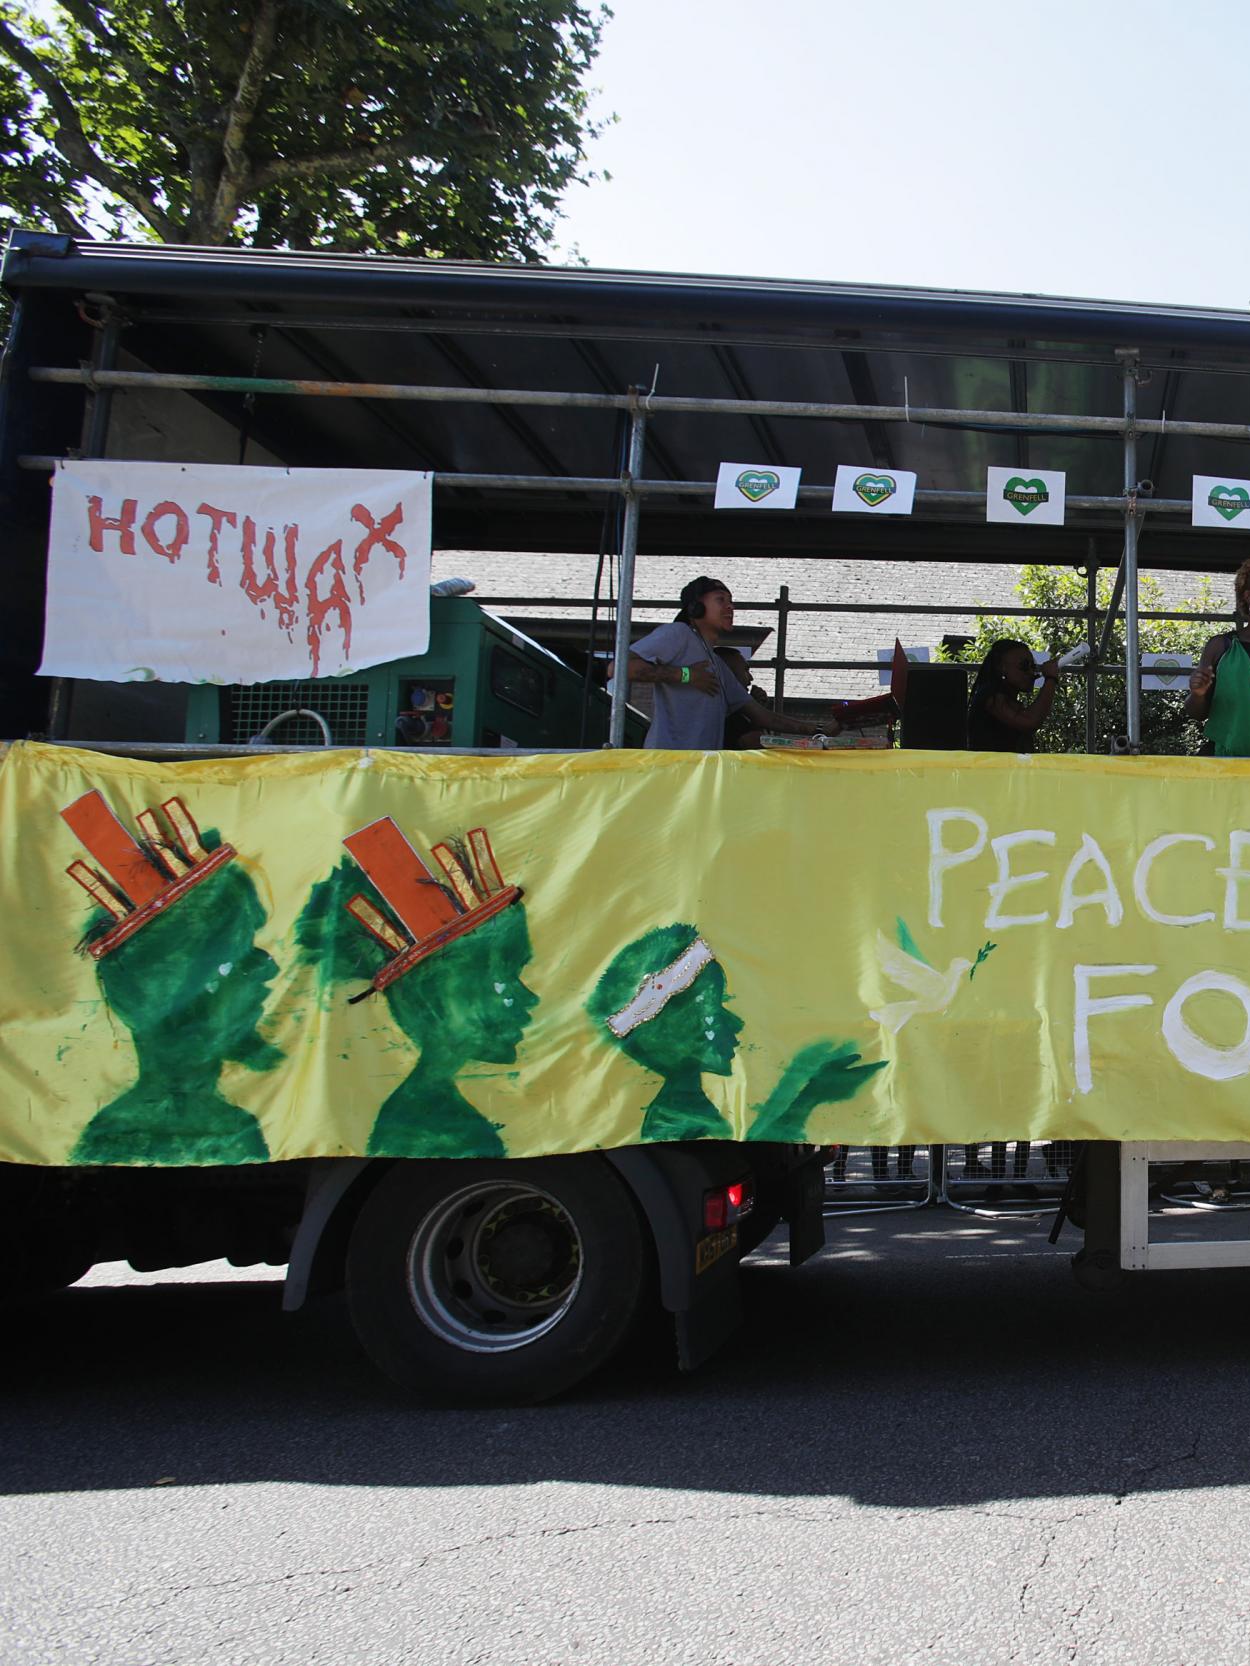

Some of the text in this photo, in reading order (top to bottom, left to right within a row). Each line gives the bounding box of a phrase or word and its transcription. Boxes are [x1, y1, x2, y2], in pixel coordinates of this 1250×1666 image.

[738, 481, 776, 490] GRENFELL
[855, 484, 892, 494] GRENFELL
[1007, 491, 1046, 501] GRENFELL
[1211, 499, 1250, 509] GRENFELL
[86, 495, 407, 678] HOTWAX
